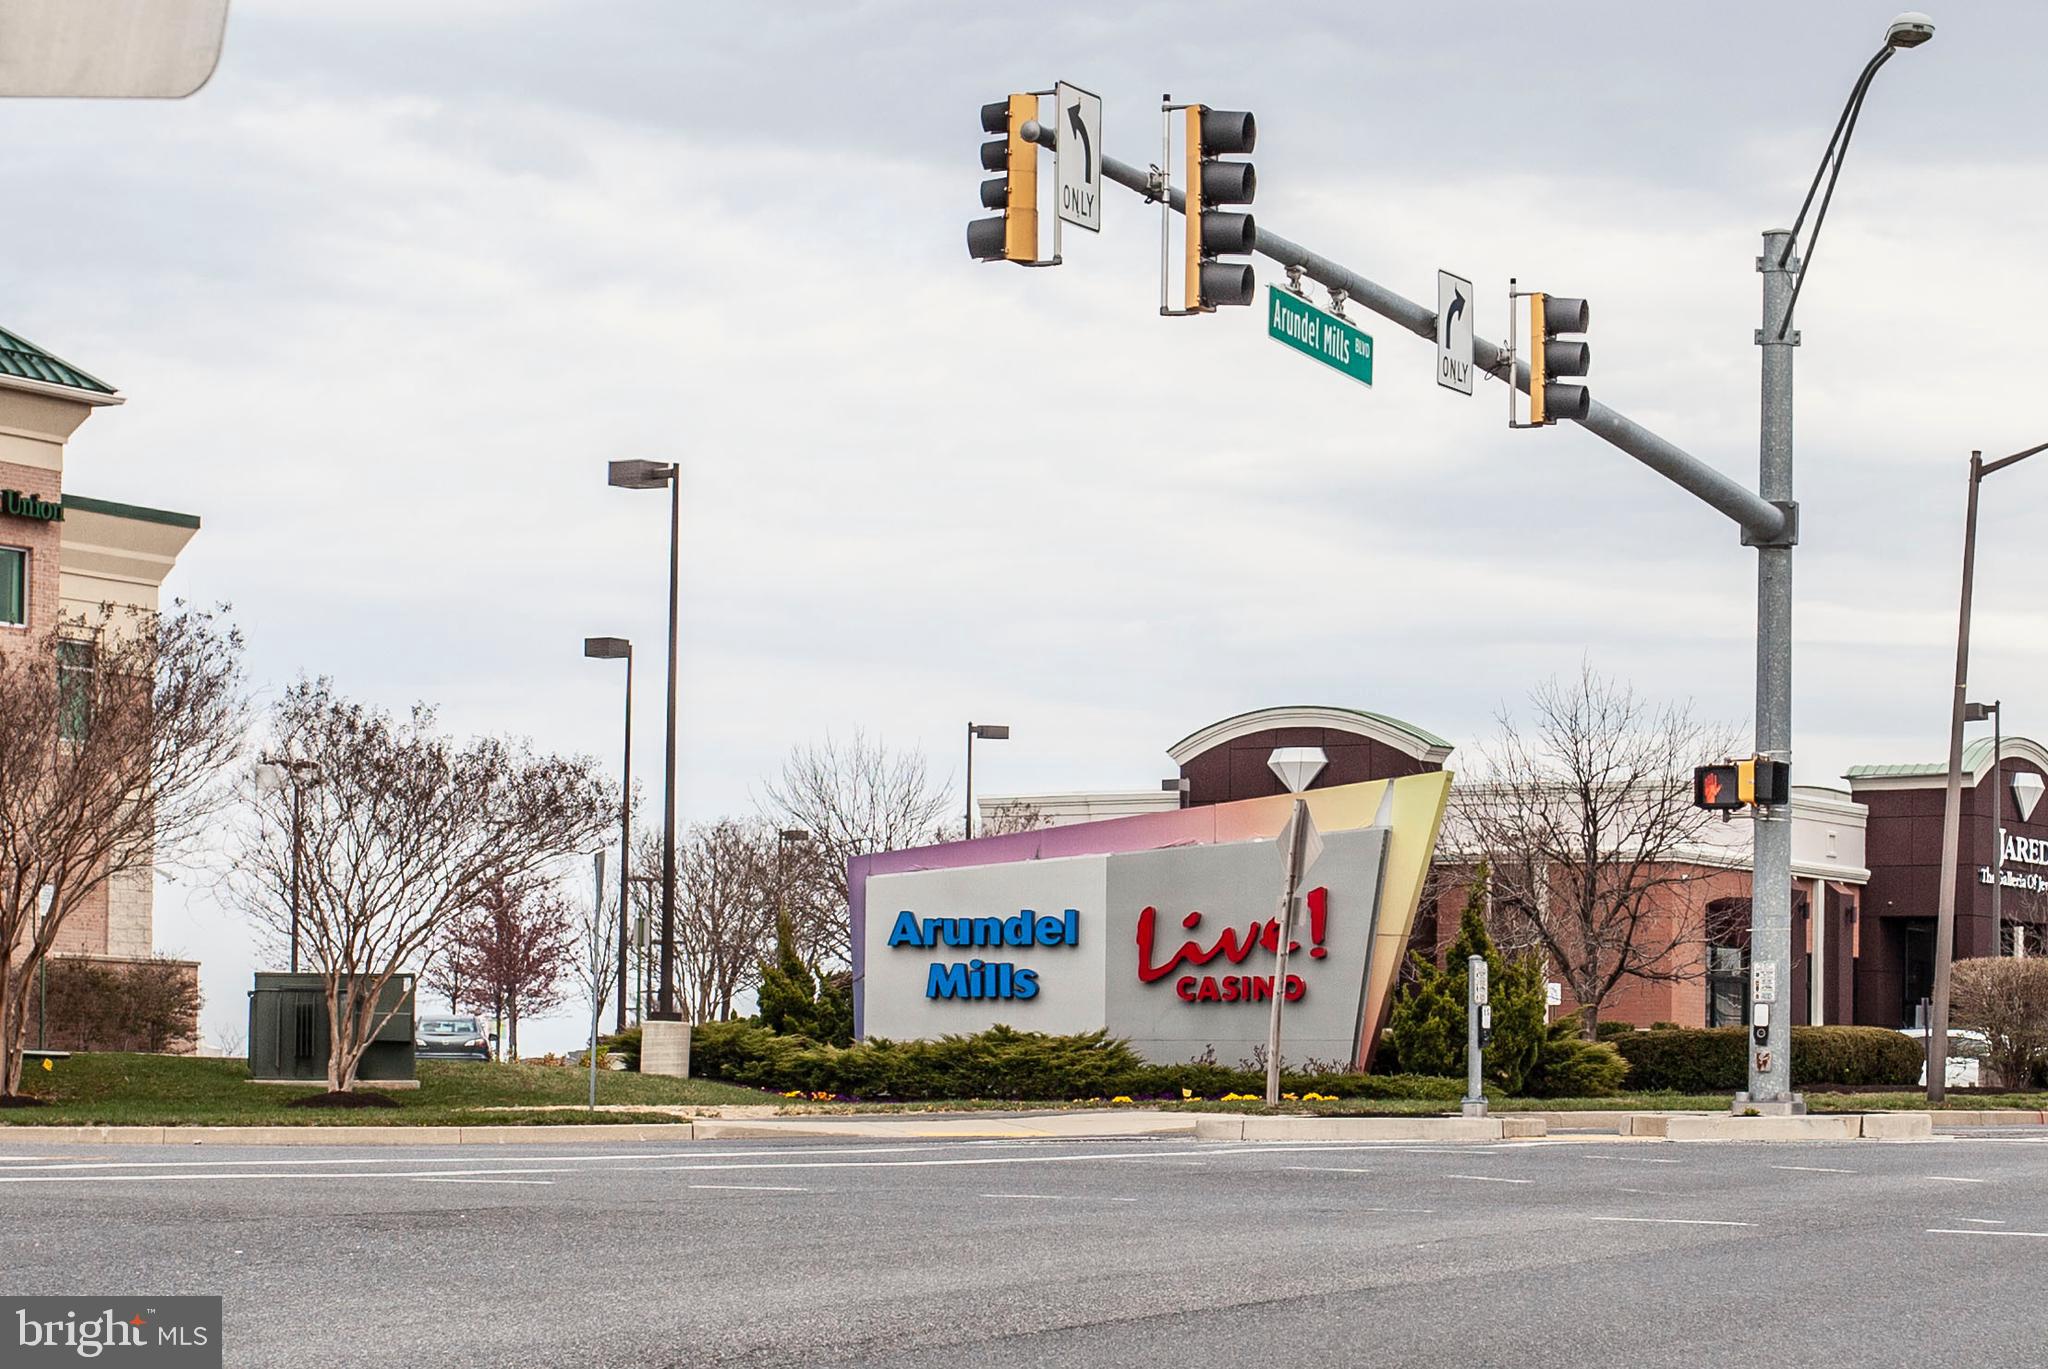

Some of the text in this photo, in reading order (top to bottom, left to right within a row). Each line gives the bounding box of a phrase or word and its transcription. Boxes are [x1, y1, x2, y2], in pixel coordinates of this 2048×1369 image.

[1063, 184, 1095, 218] ONLY
[1273, 298, 1371, 365] Arundel Mills BLVD
[1442, 356, 1469, 384] ONLY
[2, 489, 65, 522] Union
[1998, 827, 2048, 868] JARED
[887, 908, 1080, 948] Arundel
[1136, 886, 1329, 983] Live!
[926, 958, 1040, 1001] Mills
[1176, 974, 1307, 1002] CASINO
